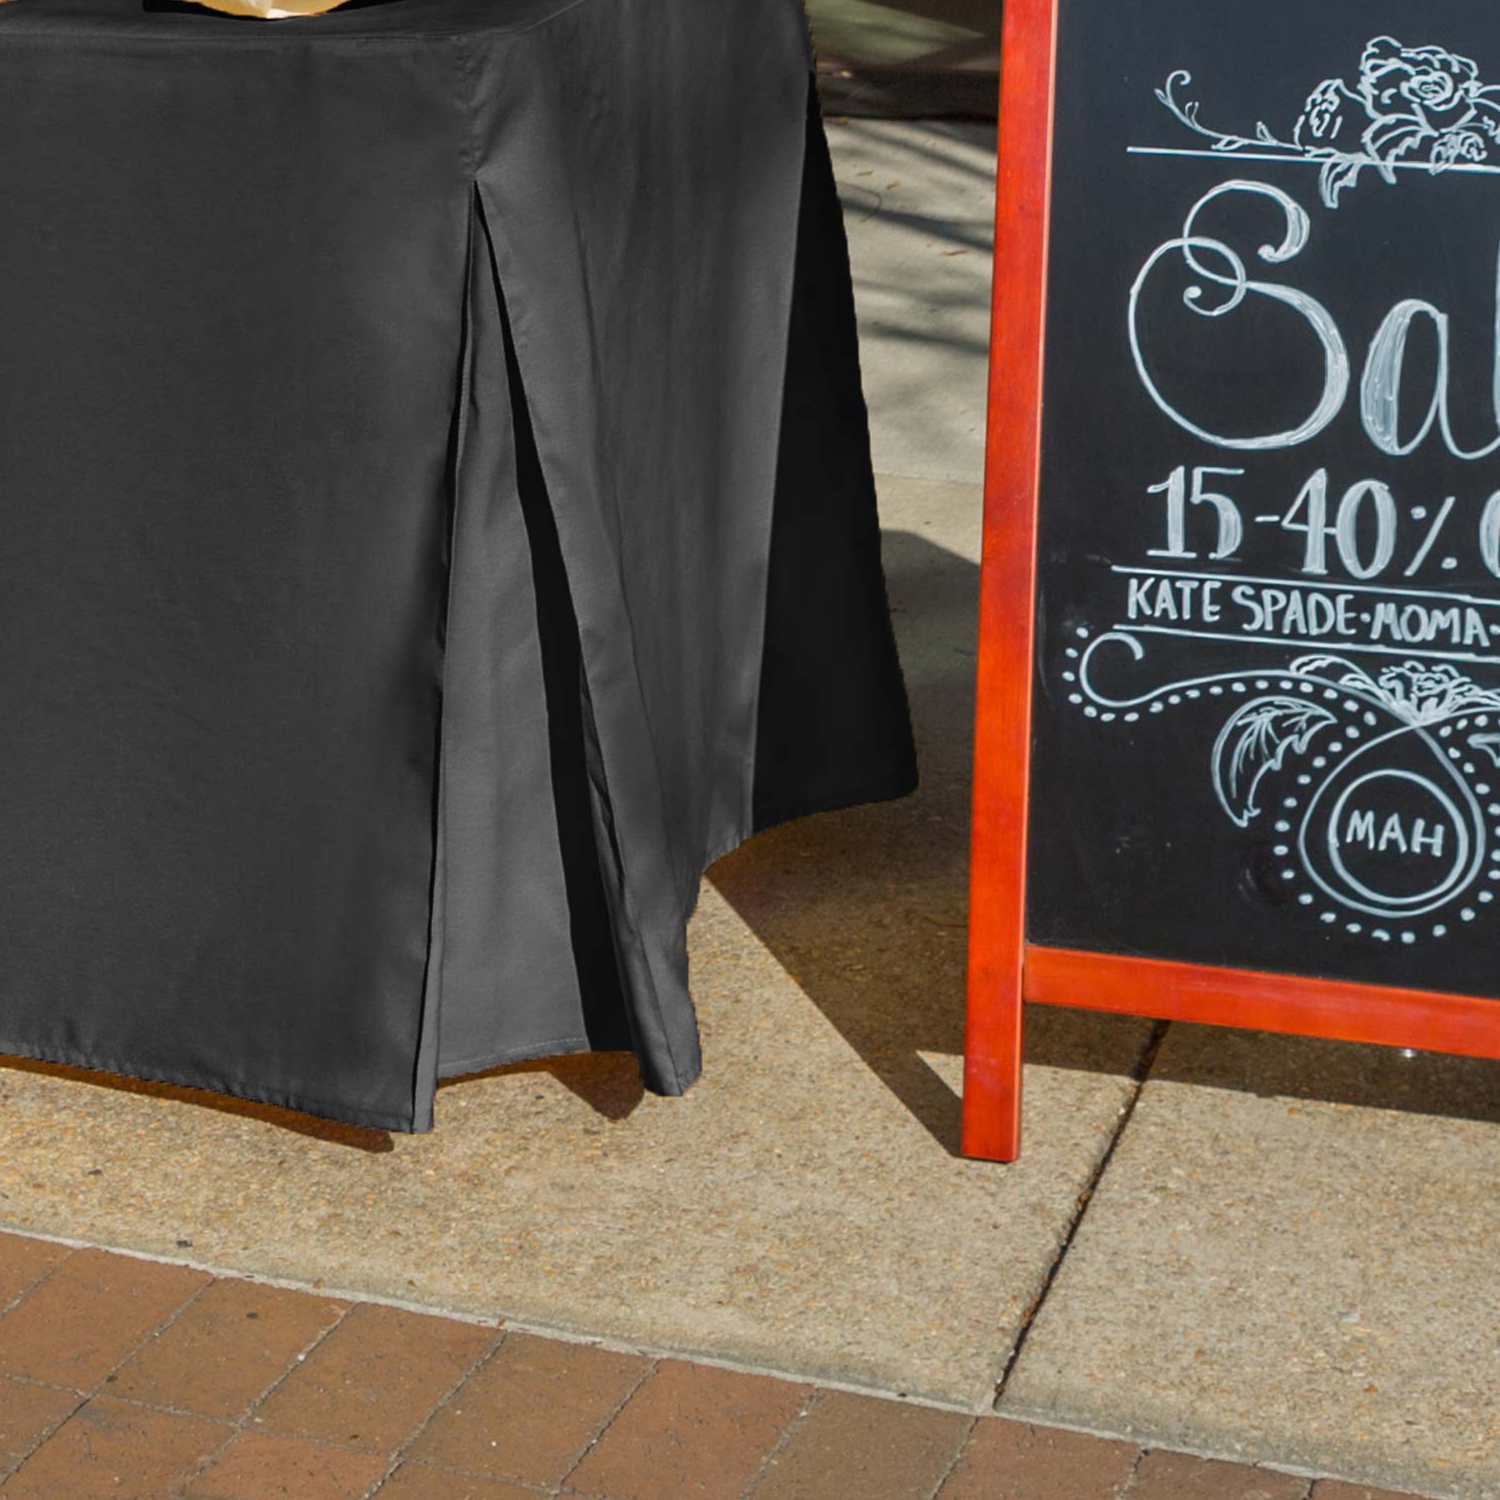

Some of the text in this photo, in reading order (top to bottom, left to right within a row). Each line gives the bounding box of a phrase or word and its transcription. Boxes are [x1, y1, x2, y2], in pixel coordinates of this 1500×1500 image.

[1128, 178, 1500, 460] Sa
[1127, 577, 1222, 622] KATE
[1345, 809, 1445, 858] MAH
